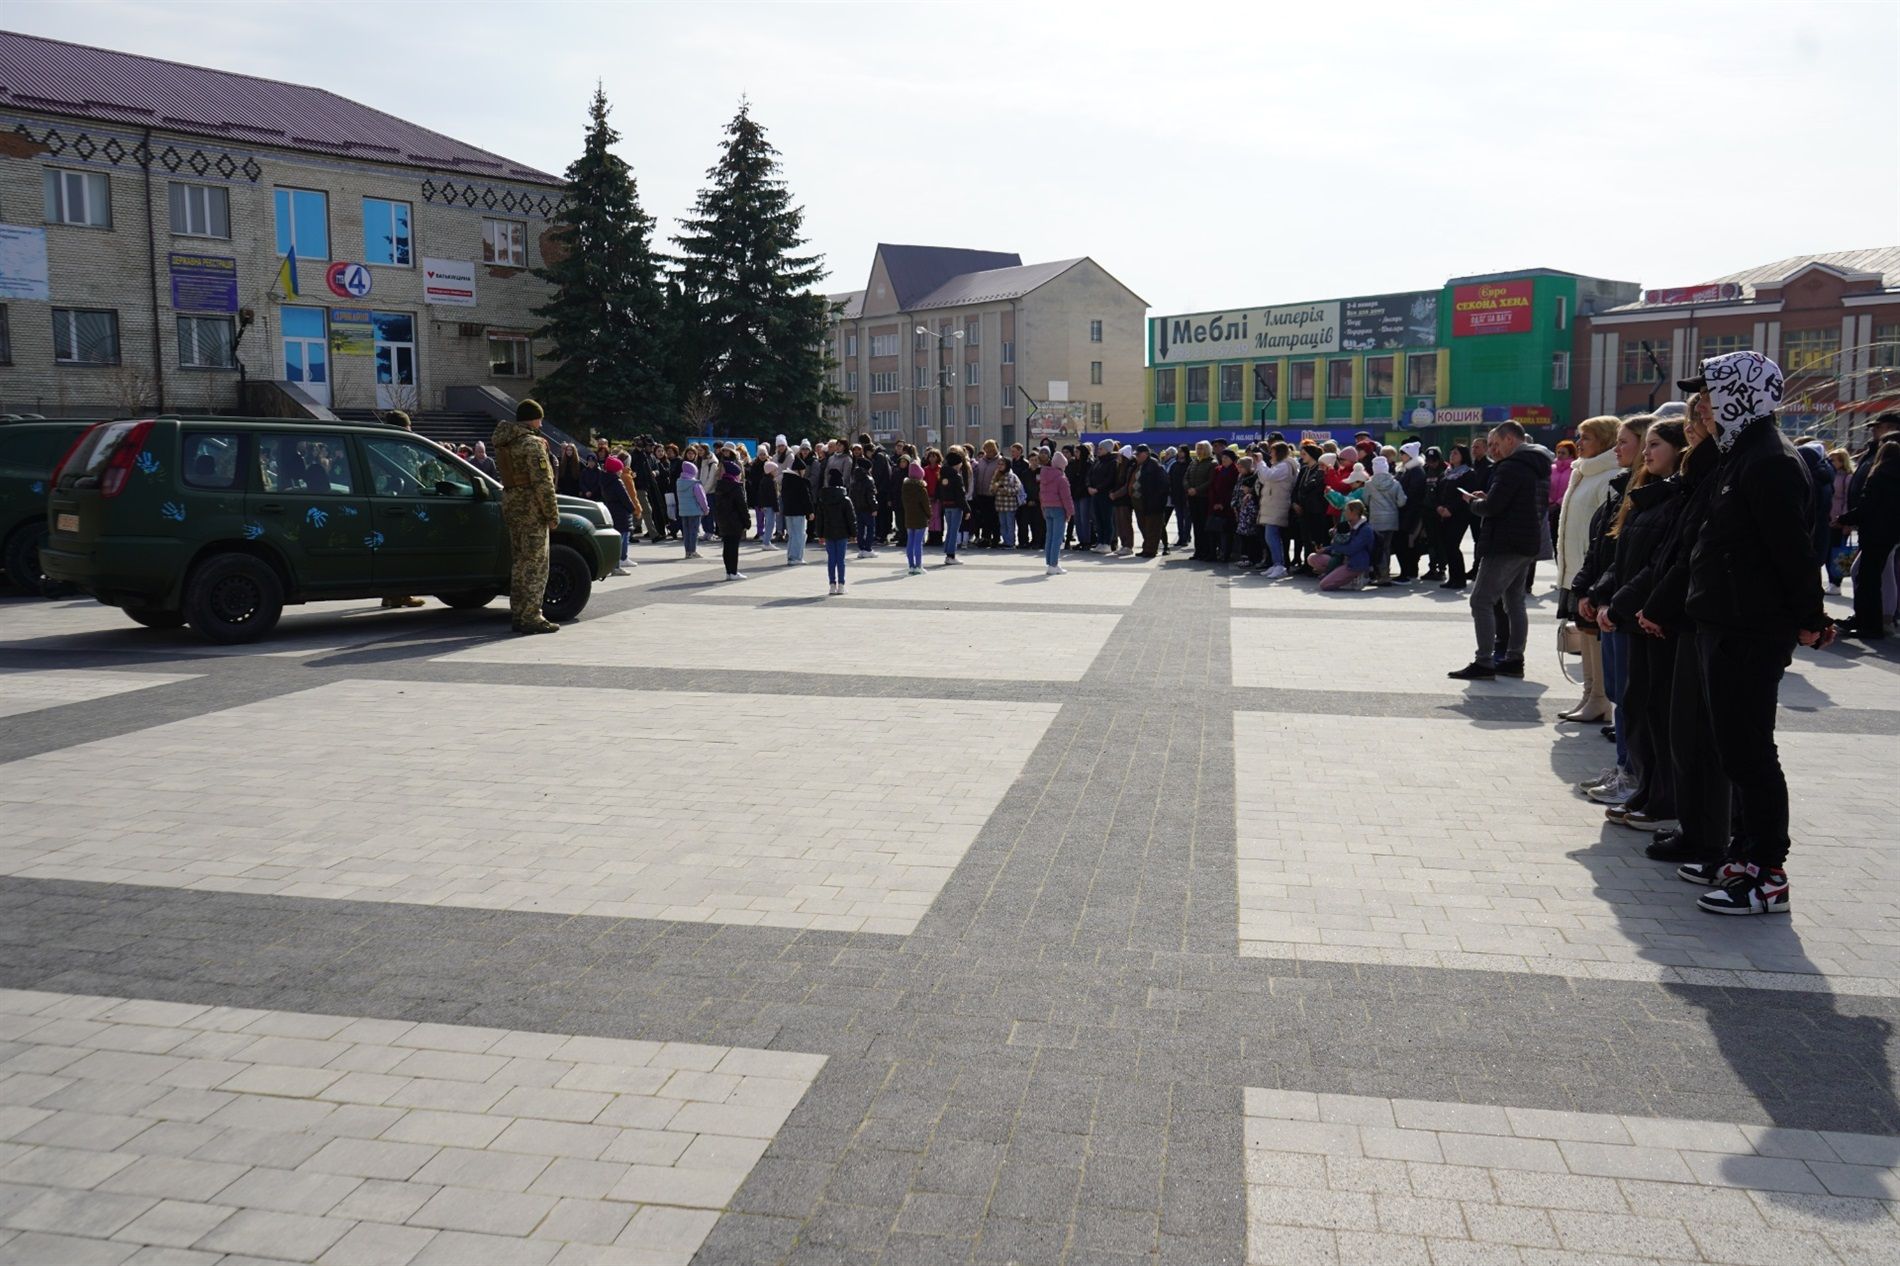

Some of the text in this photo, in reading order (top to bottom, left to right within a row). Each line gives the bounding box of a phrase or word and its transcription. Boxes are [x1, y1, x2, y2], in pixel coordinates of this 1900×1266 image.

[348, 266, 366, 295] 4
[1263, 306, 1324, 328] Імперія
[1172, 314, 1248, 345] Меблі
[1255, 327, 1333, 351] Матраців
[1437, 410, 1481, 423] КОШИК
